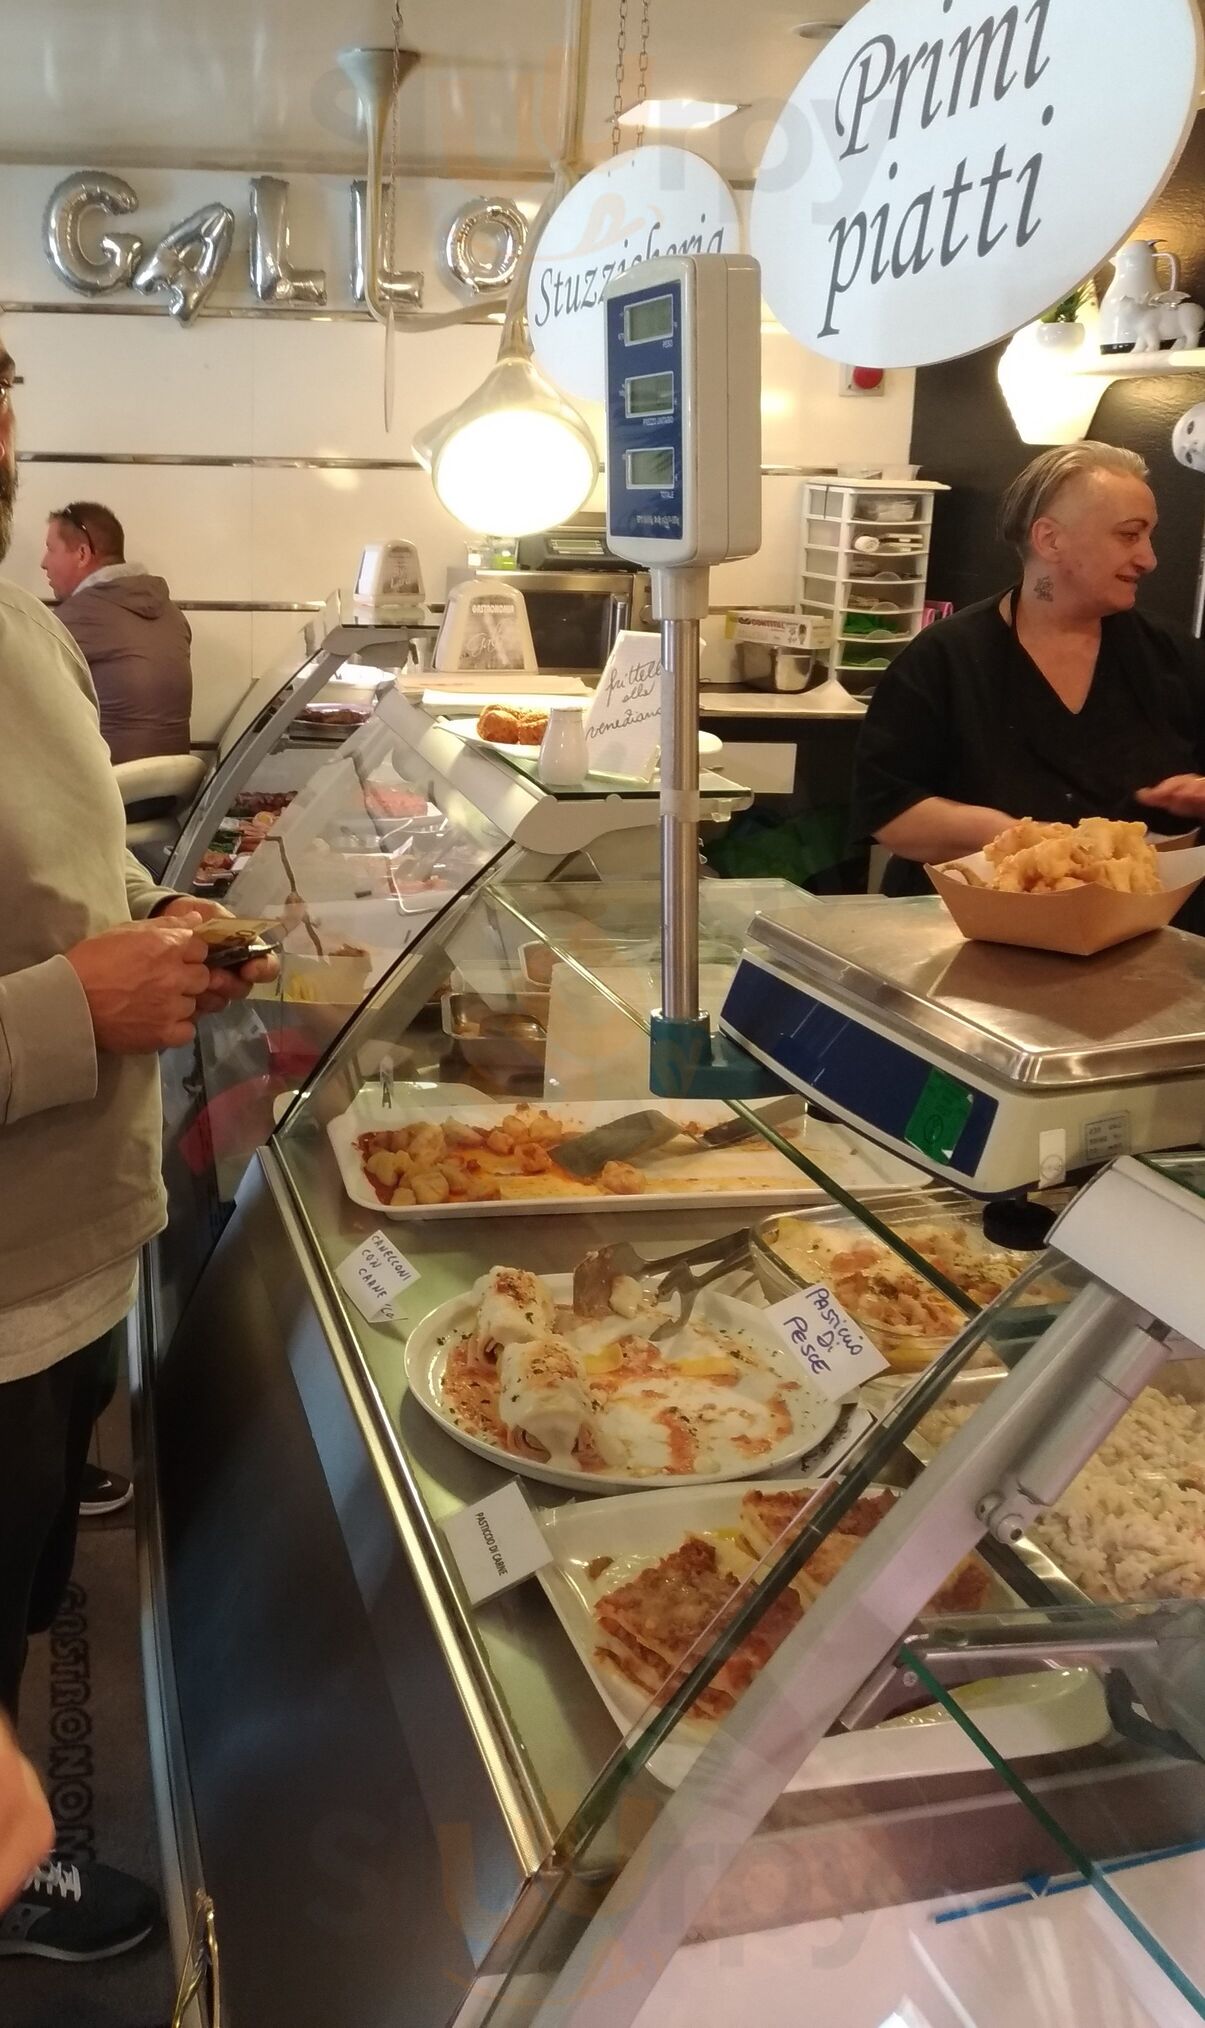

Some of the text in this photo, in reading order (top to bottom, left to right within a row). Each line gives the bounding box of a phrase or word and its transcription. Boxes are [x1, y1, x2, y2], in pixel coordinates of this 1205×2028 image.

[835, 0, 1050, 160] Primi
[42, 169, 530, 328] GALLO
[817, 104, 1054, 338] piatti
[605, 660, 662, 707] frittell
[358, 1268, 387, 1298] CARNE
[361, 1249, 382, 1268] CON
[783, 1316, 831, 1374] PESCE
[475, 1512, 508, 1576] PASTICCIO DI CARNE
[49, 1580, 97, 1868] GASTRONOM
